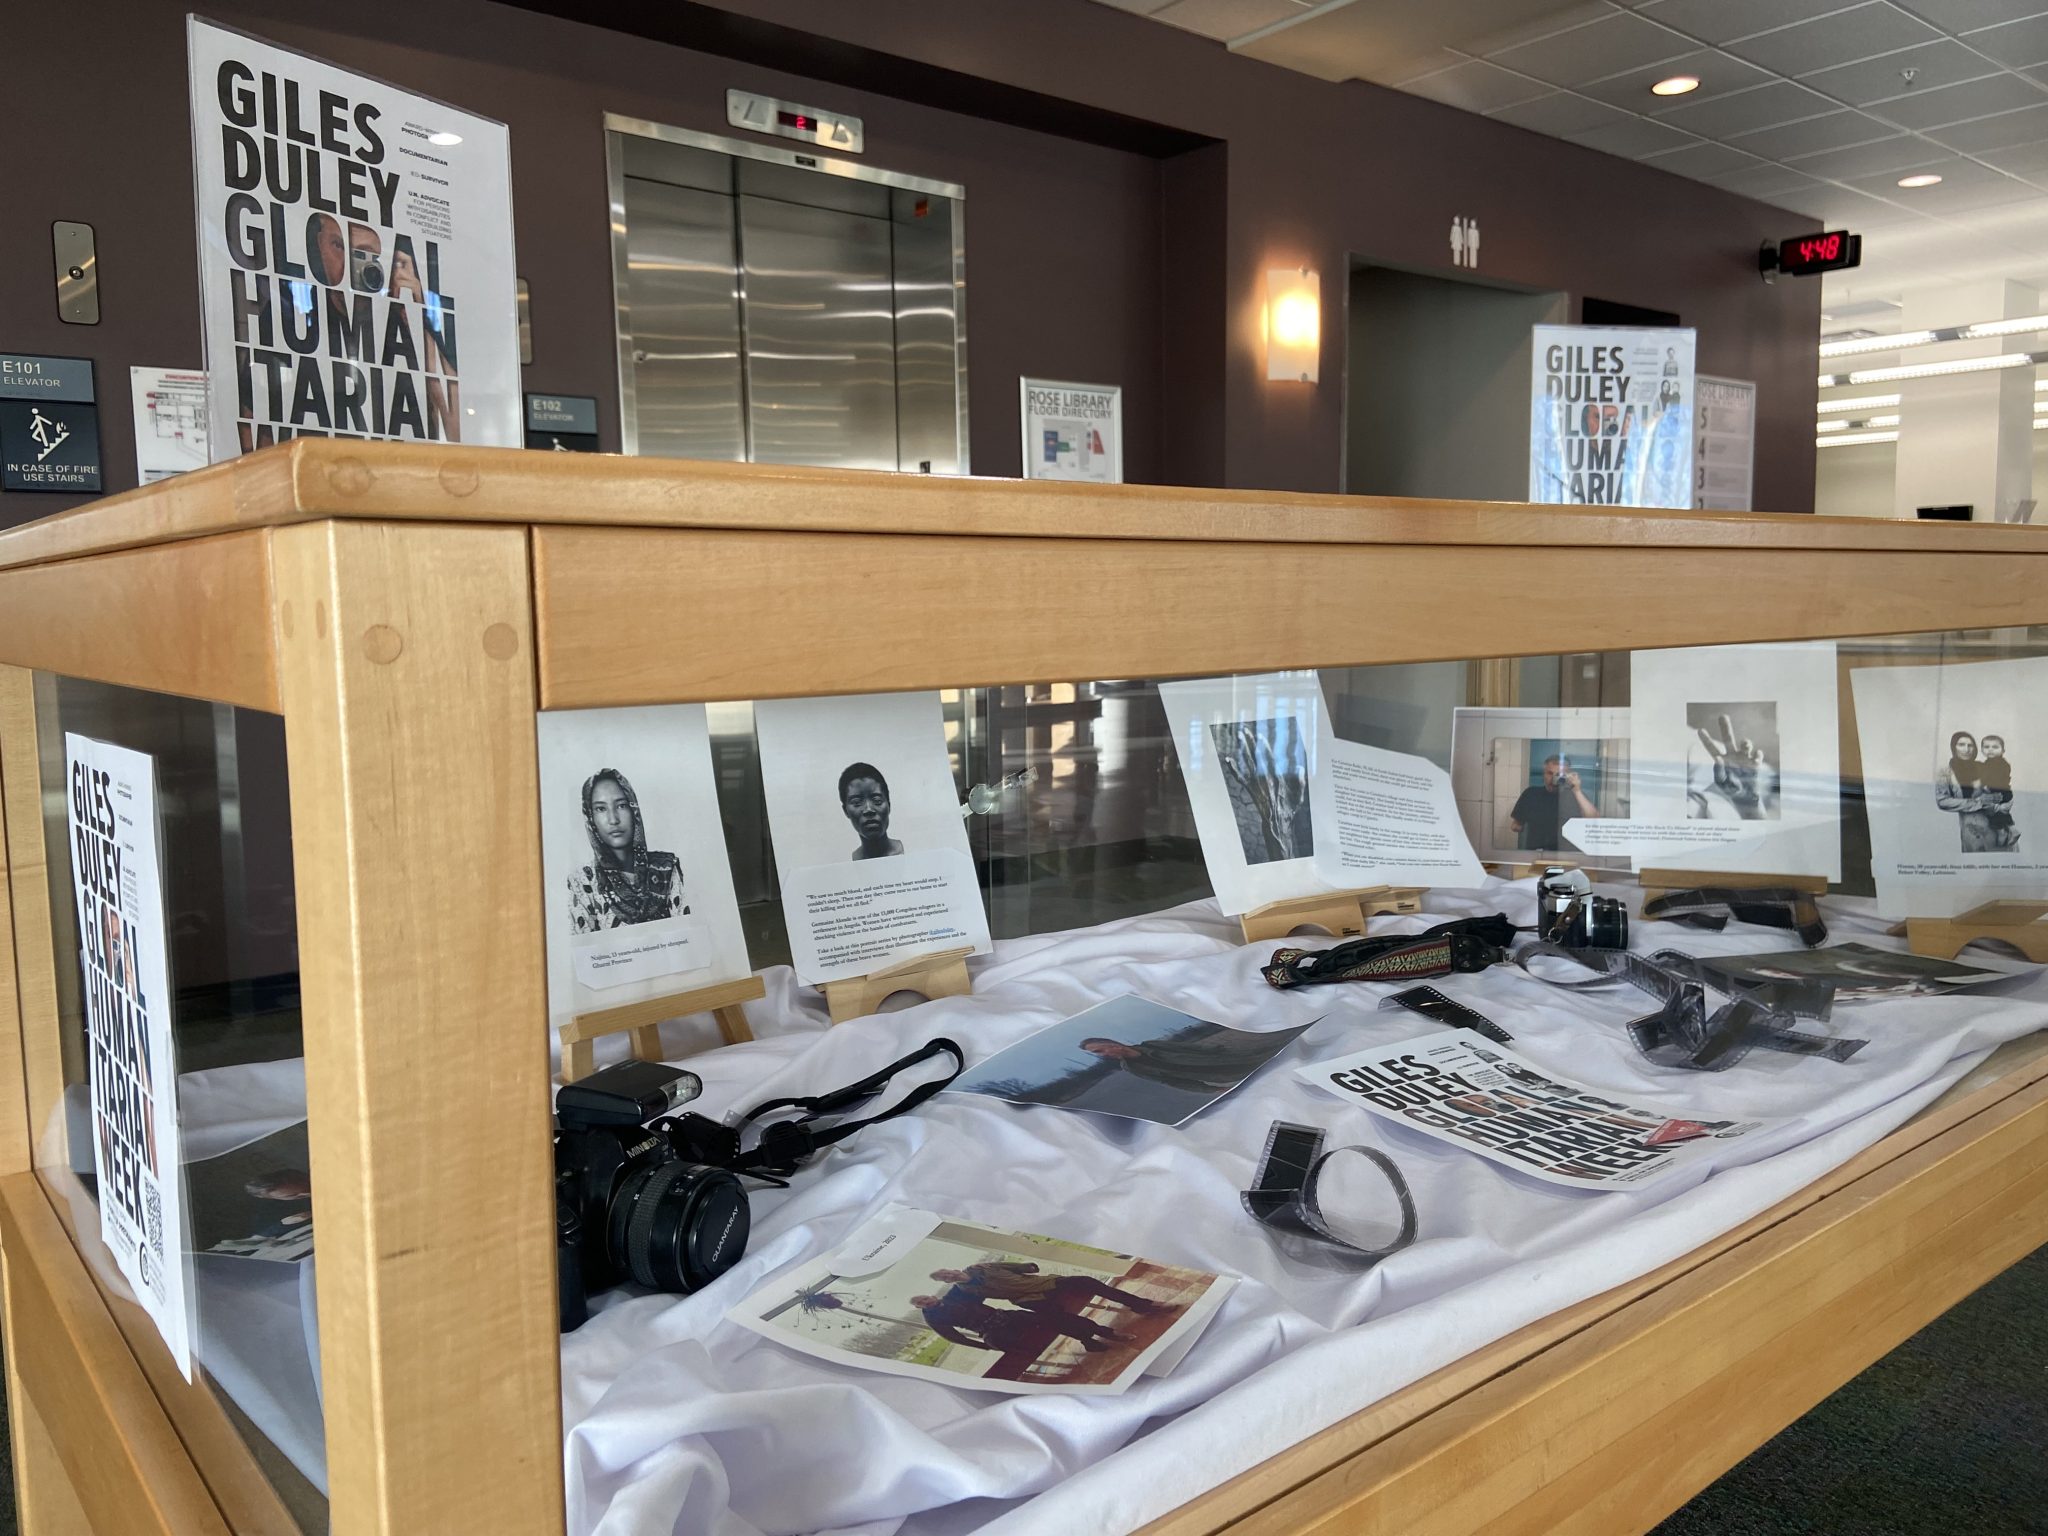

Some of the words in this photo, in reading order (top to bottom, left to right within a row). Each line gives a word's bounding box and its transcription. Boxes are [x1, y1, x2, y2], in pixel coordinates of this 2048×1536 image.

[217, 60, 385, 164] GILES
[796, 114, 806, 130] 2
[399, 147, 448, 166] DOCUMENTARIAN
[221, 124, 401, 228] DULEY
[421, 174, 449, 186] SURVIVOR
[420, 194, 450, 206] ADVOCATE
[225, 192, 455, 311] GLOBAL
[1800, 235, 1840, 262] 4:48
[230, 268, 458, 377] HUMAN
[3, 361, 41, 374] E101
[1546, 344, 1624, 374] GILES
[4, 377, 61, 387] ELEVATOR
[235, 345, 461, 443] ITARIAN
[1546, 375, 1631, 403] DULEY
[533, 399, 562, 412] E102
[1028, 391, 1060, 406] ROSE
[1063, 393, 1112, 409] LIBRARY
[1028, 405, 1059, 416] FLOOR
[1062, 407, 1112, 419] DIRECTORY
[533, 412, 575, 421] ELEVATOR
[1701, 408, 1707, 429] 5
[7, 464, 18, 472] IN
[22, 464, 52, 473] CASE
[55, 465, 70, 473] OF
[74, 466, 98, 474] FIRE
[23, 474, 45, 482] USE
[47, 474, 85, 483] STAIRS
[73, 759, 115, 840] GILES
[76, 825, 122, 912] DULEY
[895, 906, 917, 914] Congolese
[923, 908, 949, 916] experienced
[84, 888, 146, 1011] GLOBAL
[814, 933, 835, 941] shocking
[898, 931, 929, 940] photographer
[819, 960, 839, 968] strength
[89, 962, 153, 1097] HUMAN
[1330, 1055, 1440, 1093] GILES
[1361, 1072, 1482, 1111] DULEY
[95, 1038, 159, 1182] ITARIAN
[1402, 1085, 1558, 1128] GLOBAL
[1445, 1099, 1609, 1148] HUMAN
[1495, 1114, 1661, 1169] ITARIAN
[1544, 1138, 1683, 1180] WEEK
[98, 1109, 147, 1238] WEEK
[711, 1206, 740, 1263] QUANTARAY
